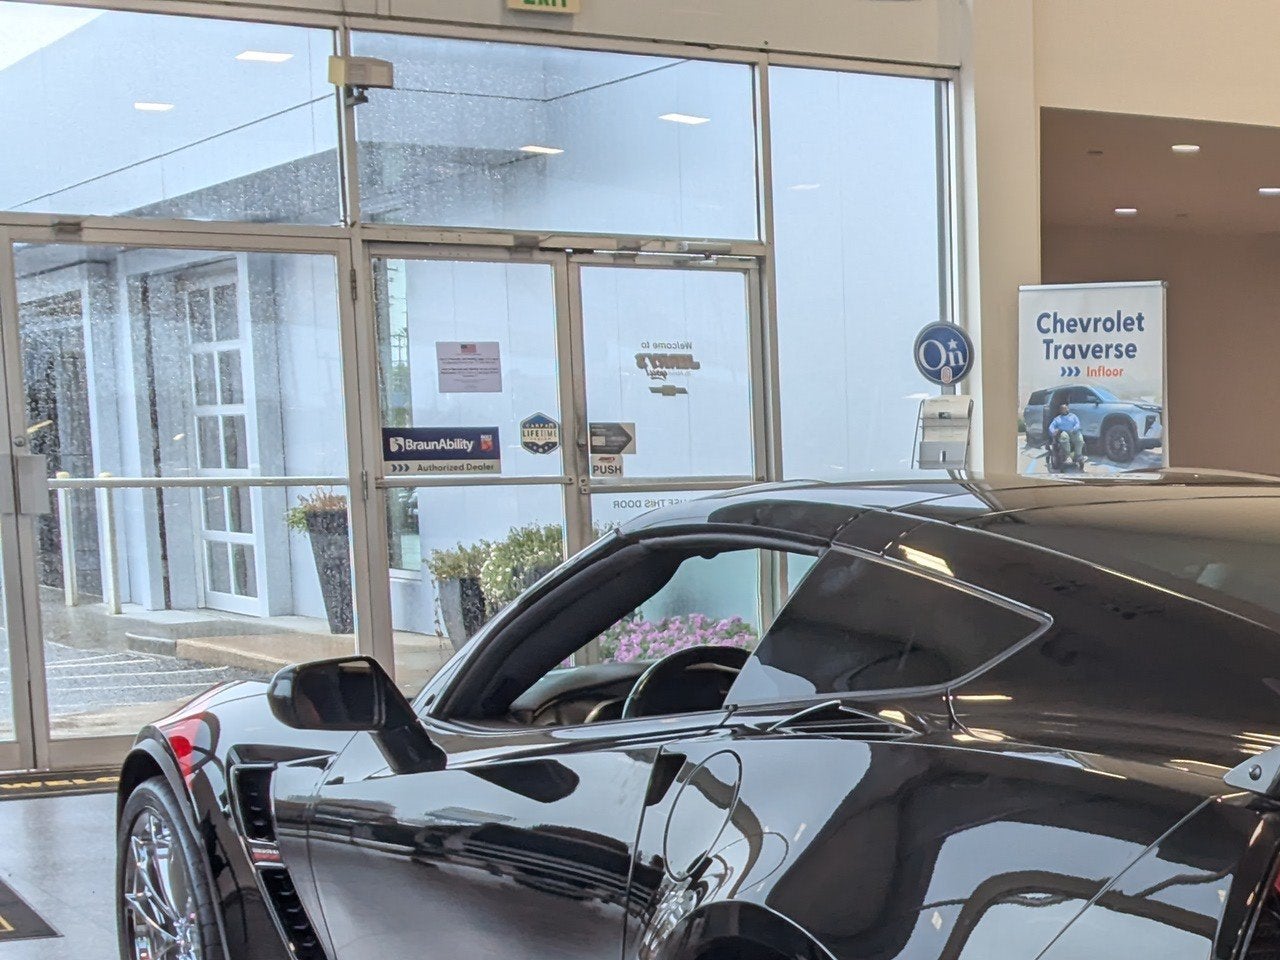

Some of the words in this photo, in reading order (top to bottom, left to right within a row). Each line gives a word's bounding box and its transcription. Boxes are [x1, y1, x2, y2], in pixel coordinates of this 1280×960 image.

[1037, 310, 1145, 335] Chevrolet
[1042, 338, 1138, 360] Traverse
[1086, 365, 1124, 377] Infloor
[405, 438, 474, 453] BraunAbility
[417, 463, 465, 472] Authorized
[466, 463, 494, 471] Dealer
[592, 465, 622, 475] PUSH
